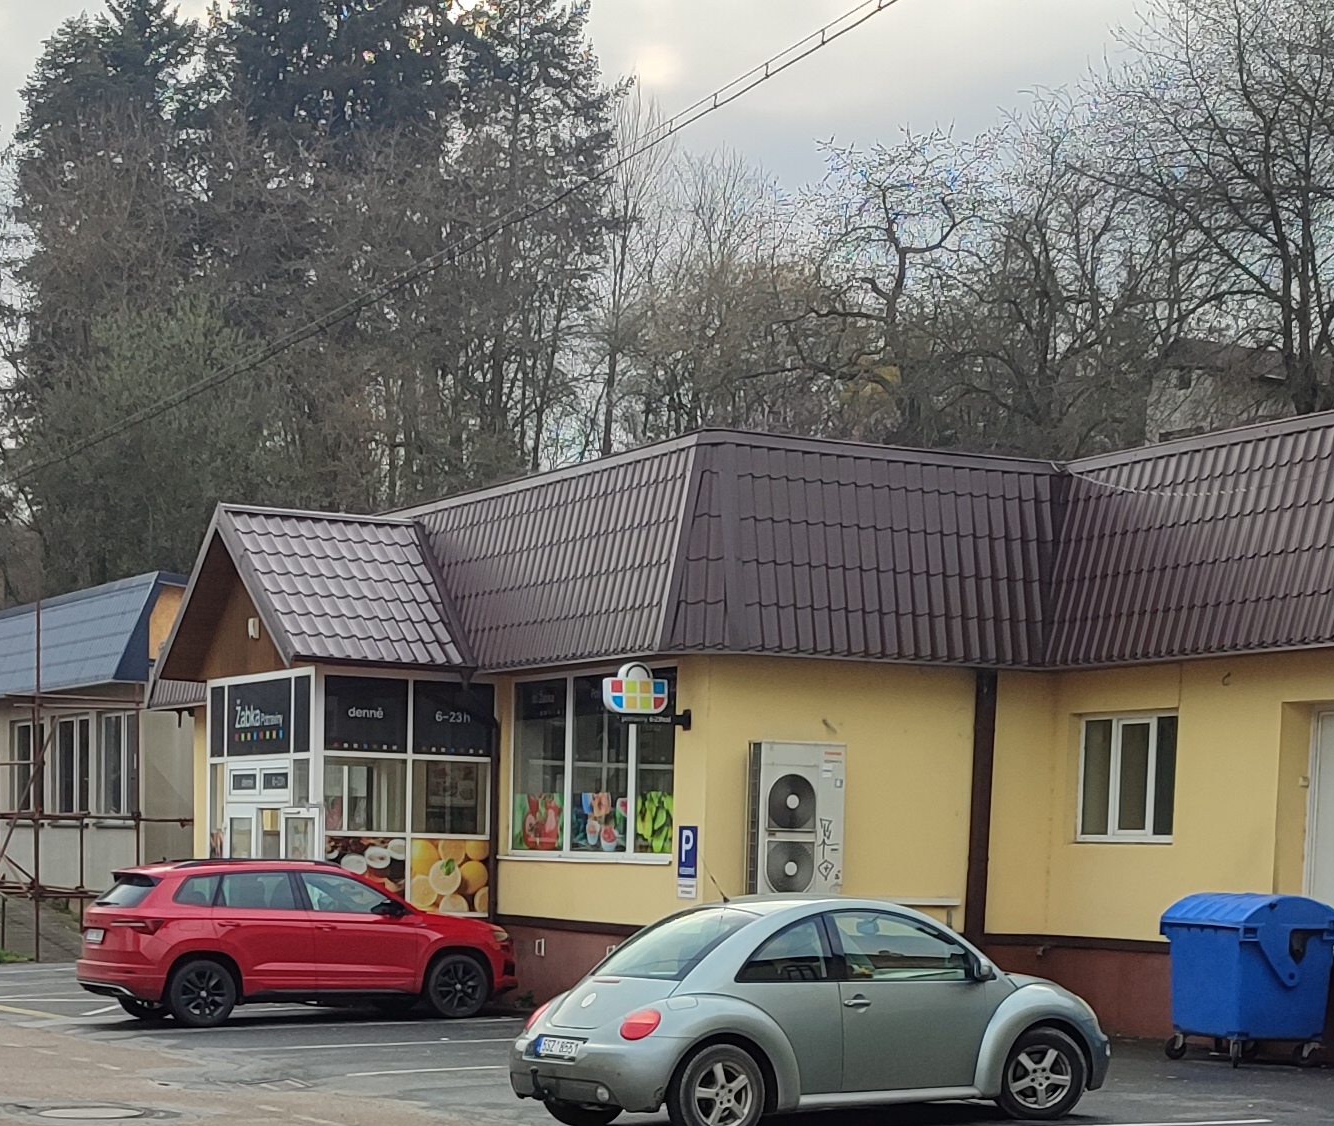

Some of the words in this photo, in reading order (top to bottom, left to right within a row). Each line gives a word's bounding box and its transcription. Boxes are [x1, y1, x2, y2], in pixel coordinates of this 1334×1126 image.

[235, 699, 261, 728] Žabka
[348, 707, 384, 719] denně
[681, 829, 694, 862] P
